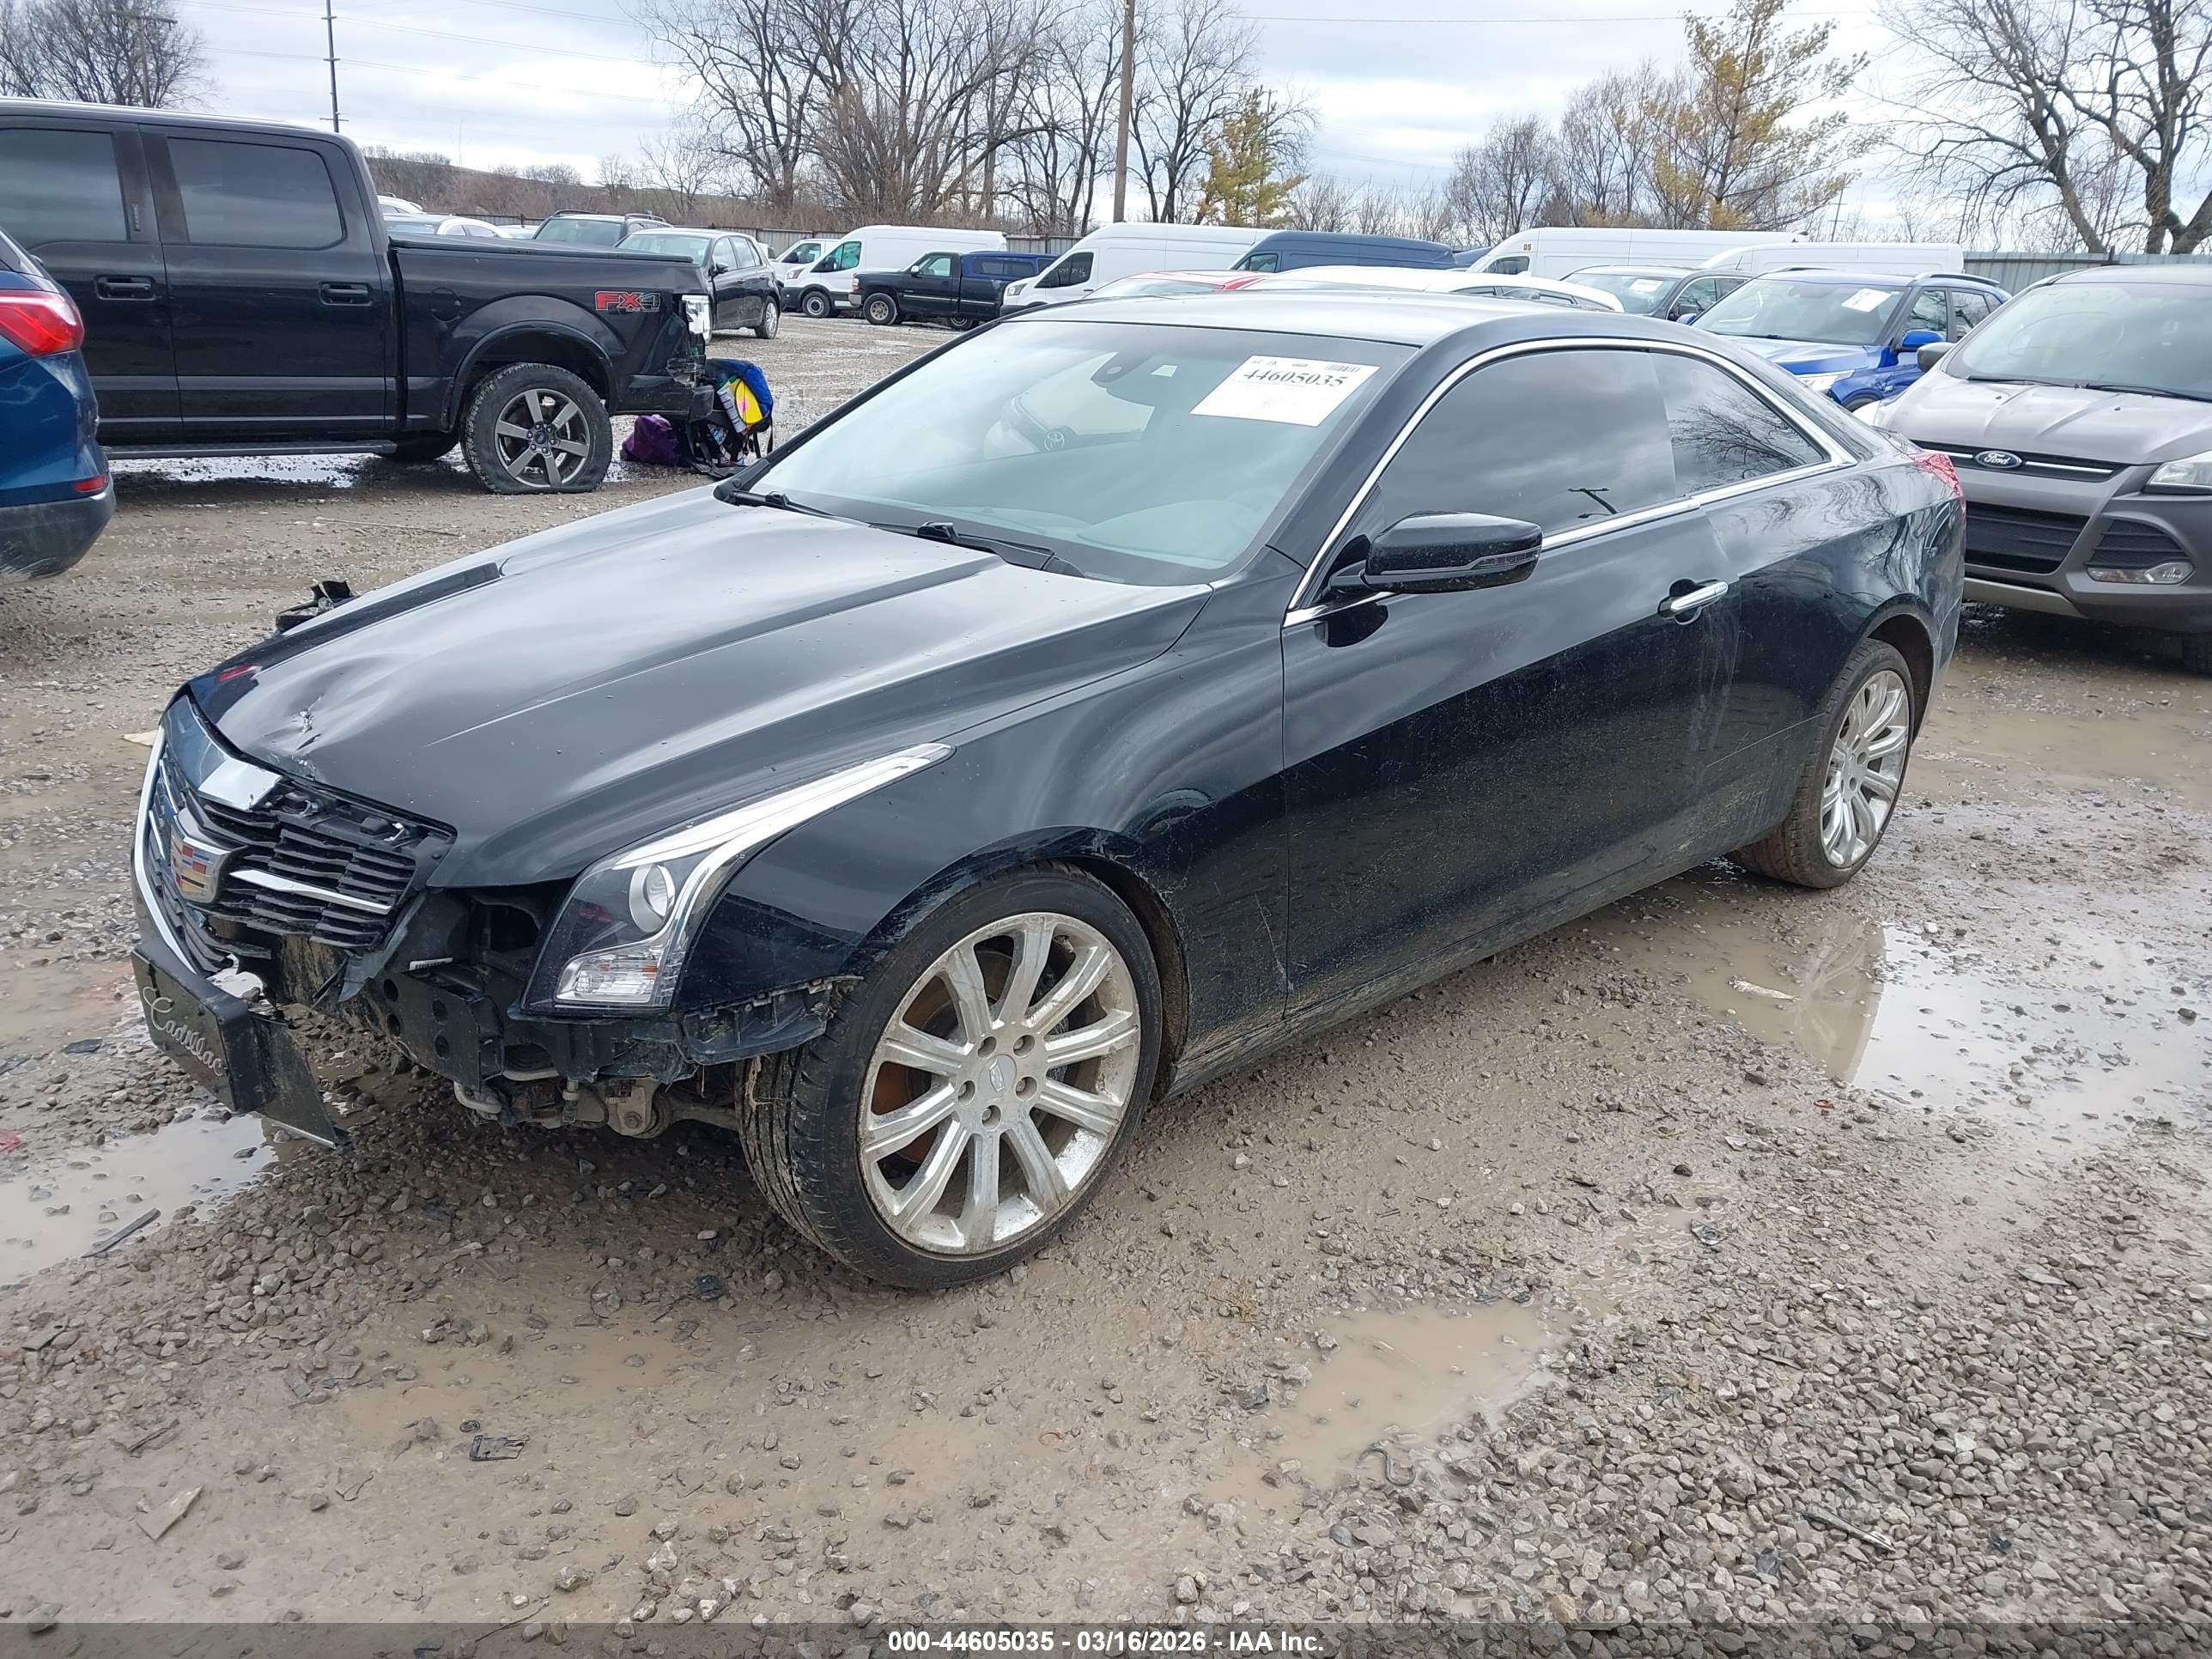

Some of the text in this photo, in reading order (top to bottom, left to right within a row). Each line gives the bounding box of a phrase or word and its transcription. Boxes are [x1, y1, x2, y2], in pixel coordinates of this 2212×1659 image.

[595, 290, 660, 311] FX4
[1243, 368, 1348, 387] 44605035
[1984, 453, 2011, 465] Ford
[143, 987, 227, 1077] Cadillac
